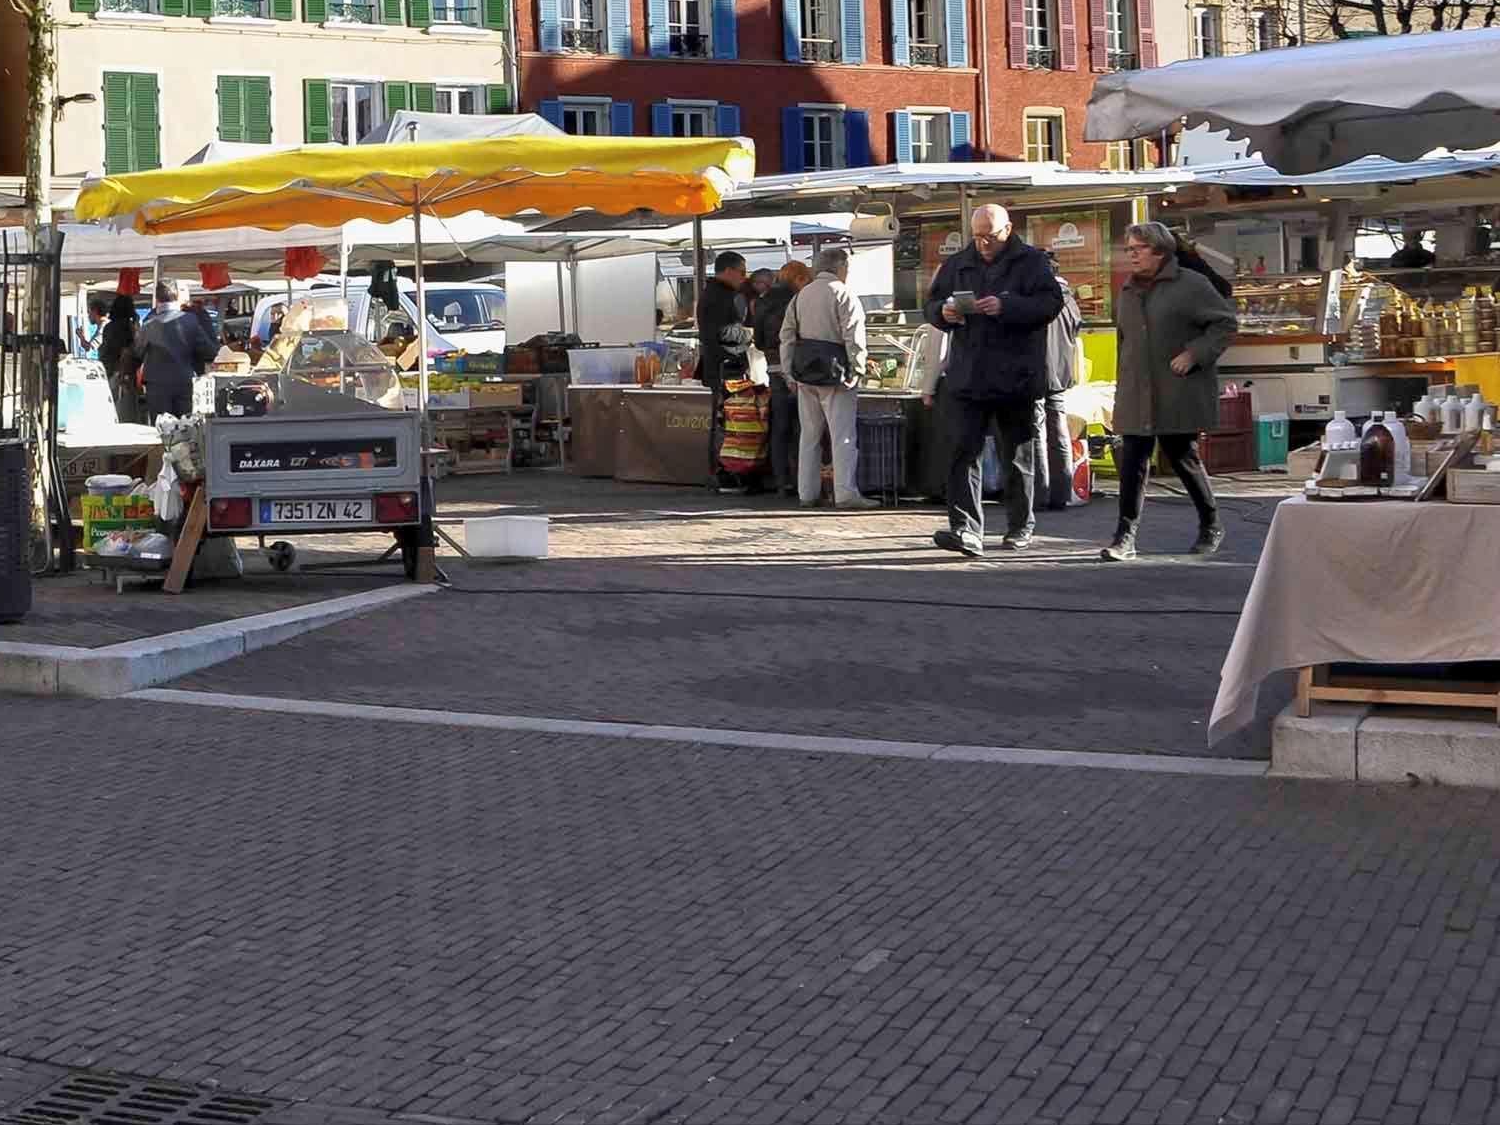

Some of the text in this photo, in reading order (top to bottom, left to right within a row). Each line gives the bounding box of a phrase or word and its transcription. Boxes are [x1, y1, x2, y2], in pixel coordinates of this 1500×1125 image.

[239, 459, 281, 468] DAXARA
[275, 503, 313, 520] 7351
[317, 502, 337, 519] ZN
[343, 502, 363, 518] 42
